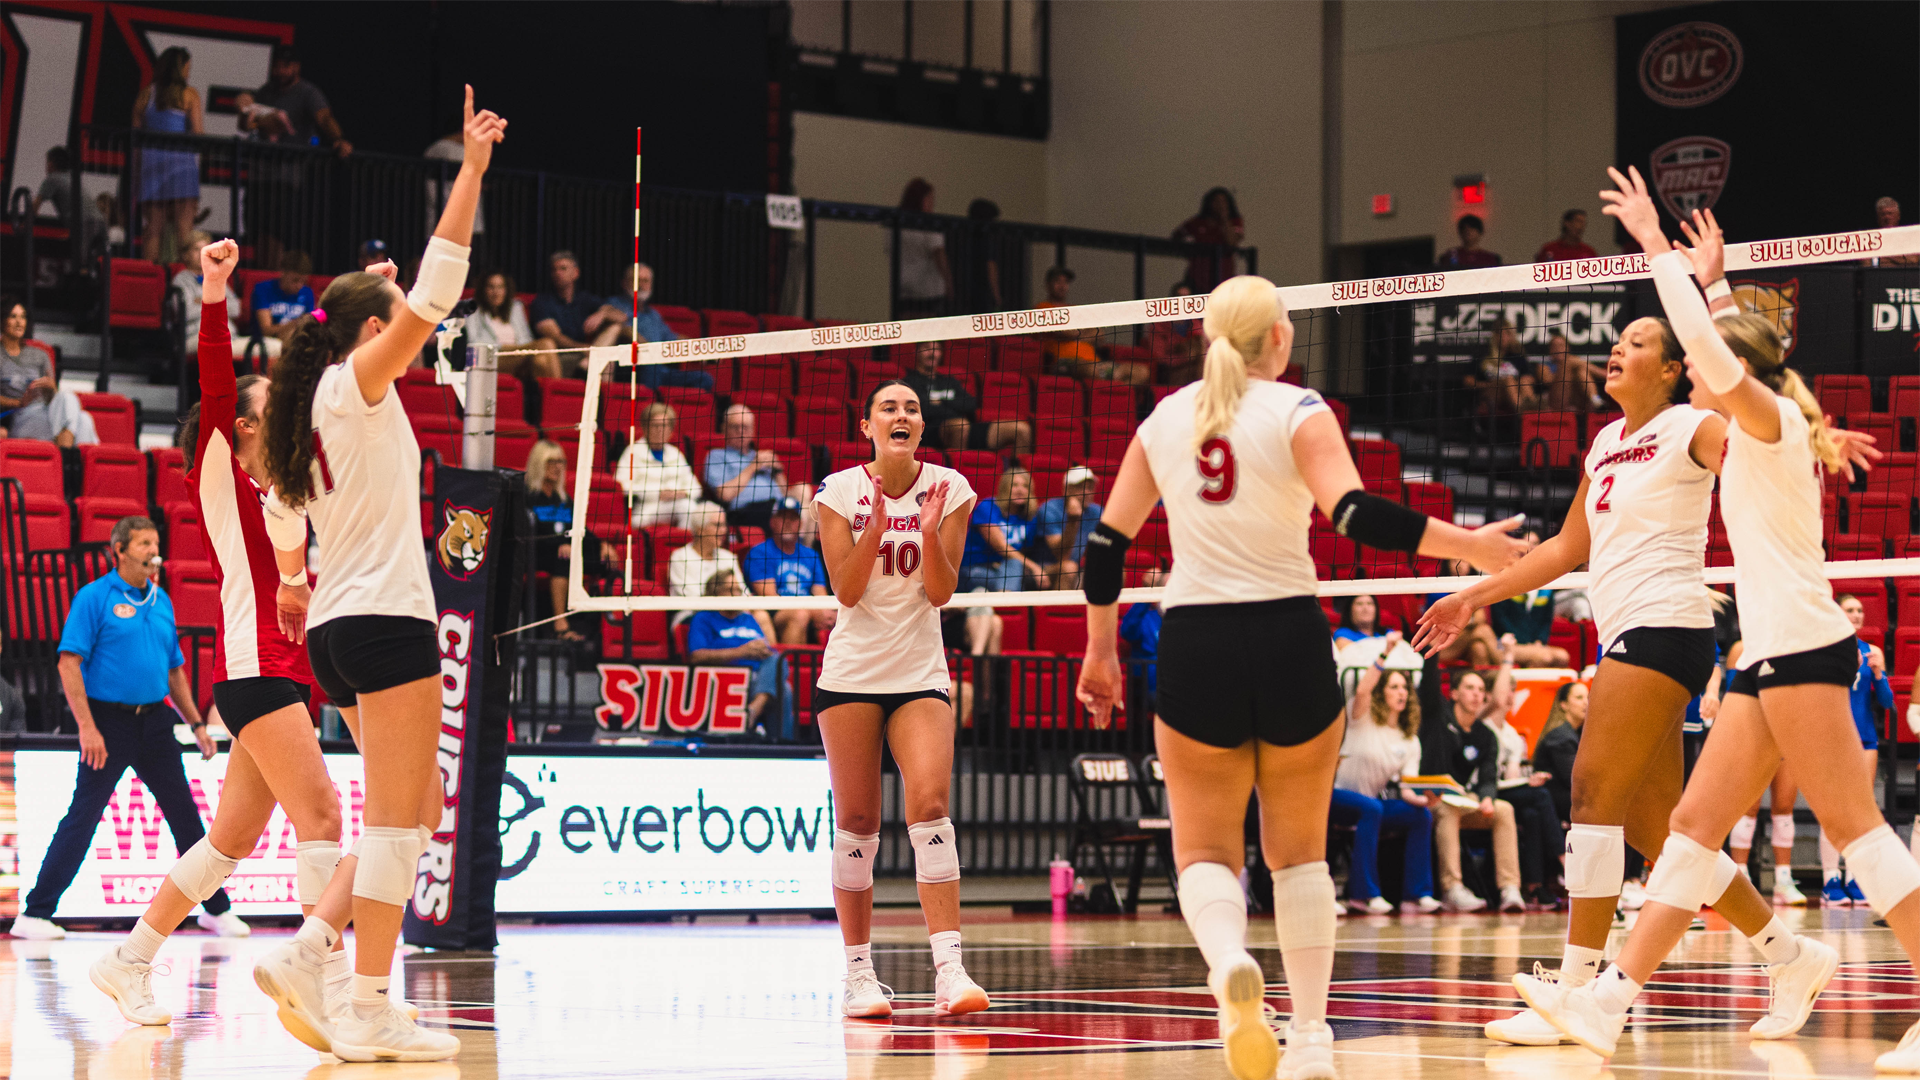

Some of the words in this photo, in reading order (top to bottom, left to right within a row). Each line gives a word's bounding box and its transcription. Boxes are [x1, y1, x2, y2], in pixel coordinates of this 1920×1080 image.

[1660, 49, 1718, 82] OVC
[1660, 165, 1724, 190] MAC
[771, 203, 798, 221] 105
[1750, 240, 1793, 262] SIUE
[1797, 232, 1882, 257] COUGARS
[1533, 261, 1572, 282] SIUE
[1576, 254, 1651, 278] COUGARS
[1332, 280, 1368, 300] SIUE
[1372, 274, 1445, 296] COUGARS
[972, 314, 1003, 331] SIUE
[1007, 309, 1070, 328] COUGARS
[1145, 298, 1179, 317] SIUE
[811, 328, 840, 345] SIUE
[844, 323, 902, 341] COUGARS
[1503, 301, 1622, 345] DECK
[662, 341, 689, 357] SIUE
[691, 336, 746, 355] COUGARS
[1196, 434, 1239, 506] 9
[1595, 473, 1616, 513] 2
[877, 541, 921, 578] 10
[595, 664, 751, 733] SIUE
[1082, 760, 1129, 781] SIUE
[559, 788, 834, 853] everbowl
[604, 880, 668, 895] CRAFT
[680, 880, 802, 895] SUPERFOOD
